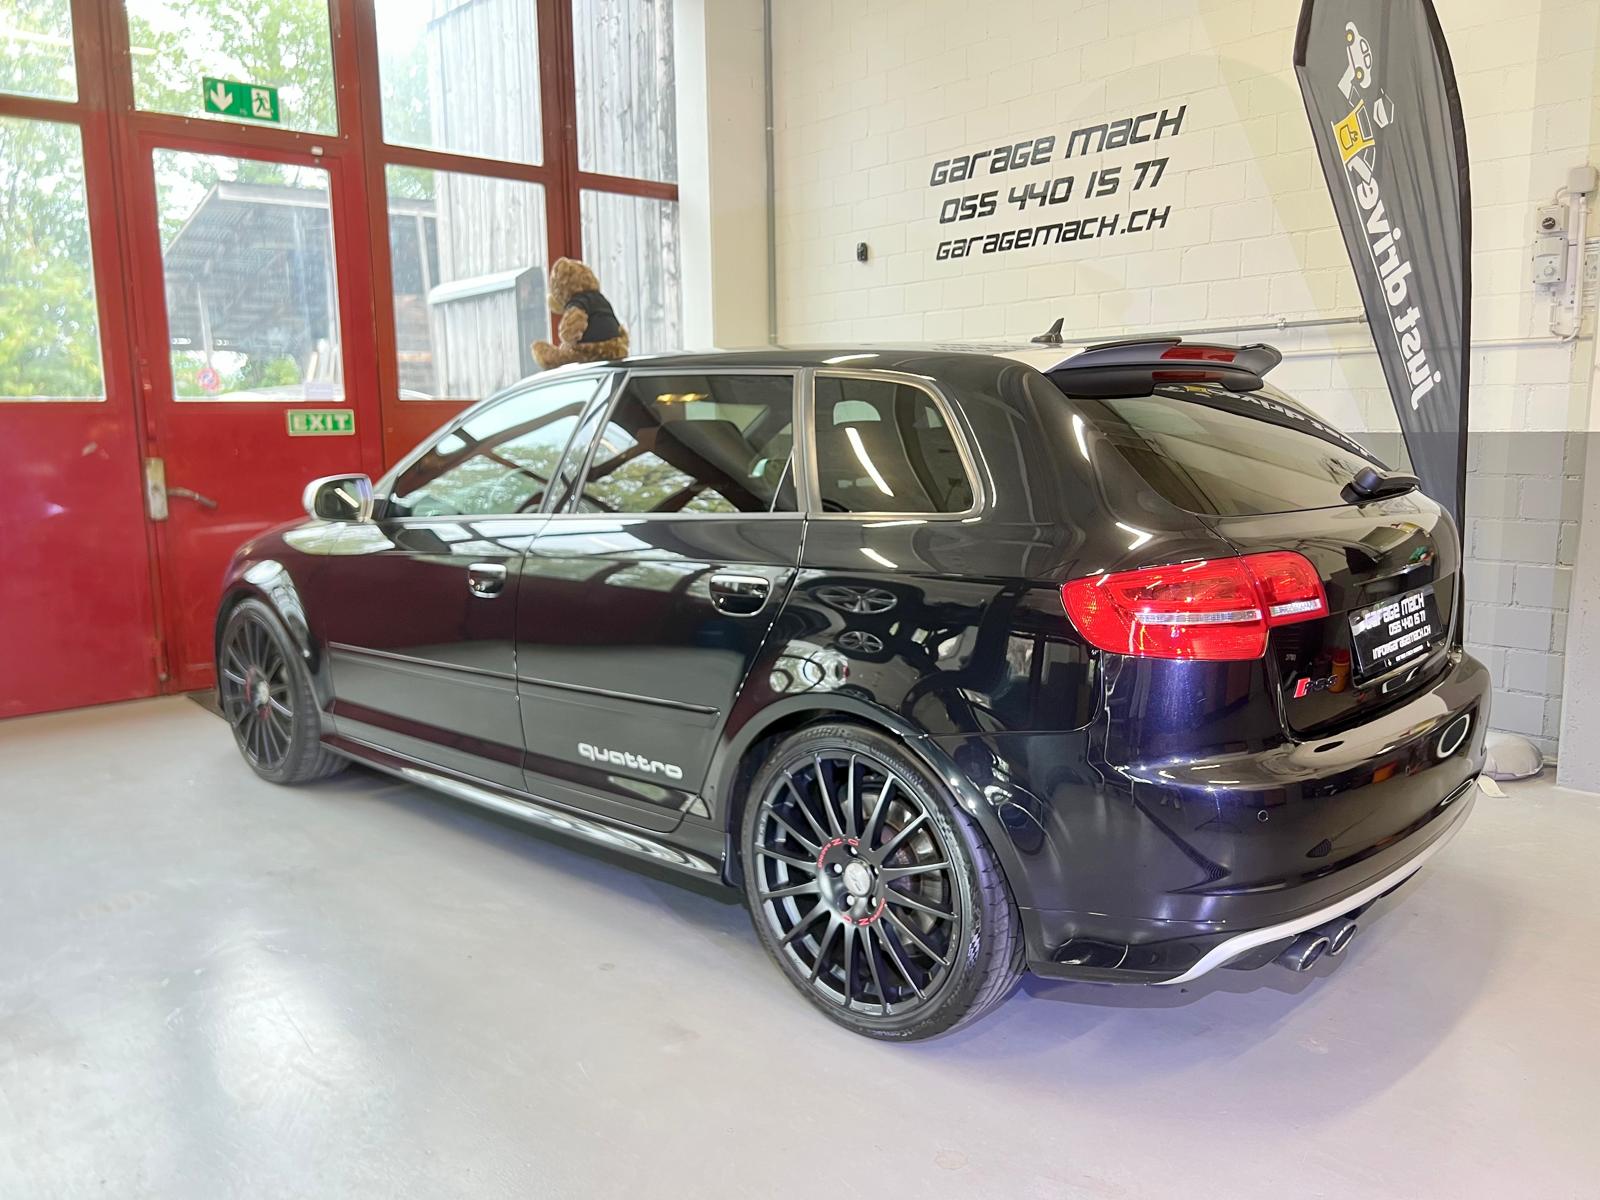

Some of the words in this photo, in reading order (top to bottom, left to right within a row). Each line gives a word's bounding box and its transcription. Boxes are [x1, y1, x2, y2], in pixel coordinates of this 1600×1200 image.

[939, 190, 999, 224] 055
[1007, 175, 1075, 210] 440
[1084, 166, 1122, 199] 15
[1132, 157, 1170, 191] 77
[293, 413, 350, 432] EXIT
[577, 742, 683, 780] quattro
